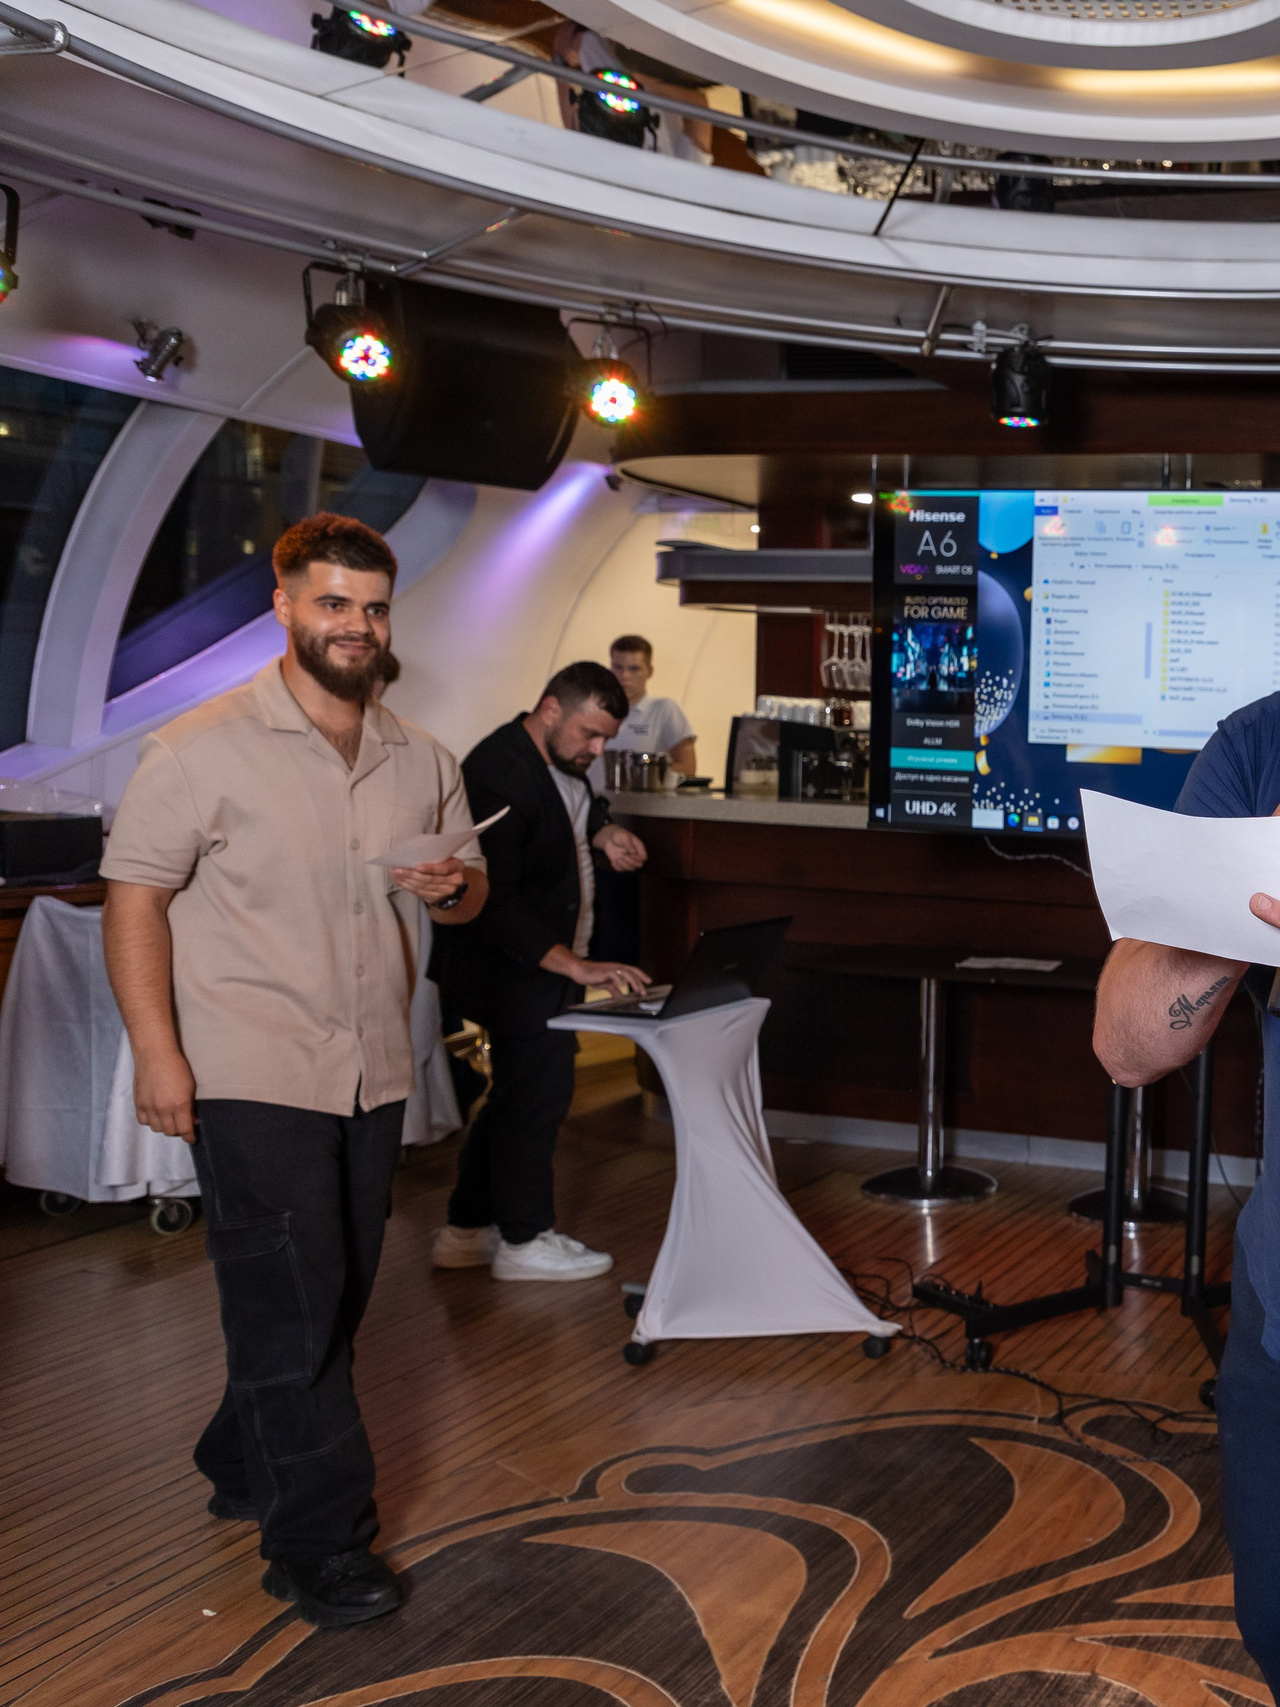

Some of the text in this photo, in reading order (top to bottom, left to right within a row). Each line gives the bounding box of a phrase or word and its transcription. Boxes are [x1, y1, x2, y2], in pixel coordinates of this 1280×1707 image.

[908, 509, 966, 522] Hisense
[916, 529, 958, 558] A6
[935, 564, 960, 575] SMART
[960, 564, 974, 575] OS
[904, 595, 927, 606] AUTO
[903, 605, 968, 620] FOR GAME
[905, 717, 924, 728] Dolby
[925, 718, 944, 727] Vision
[894, 771, 919, 782] Доступ
[904, 799, 957, 817] UHD 4K
